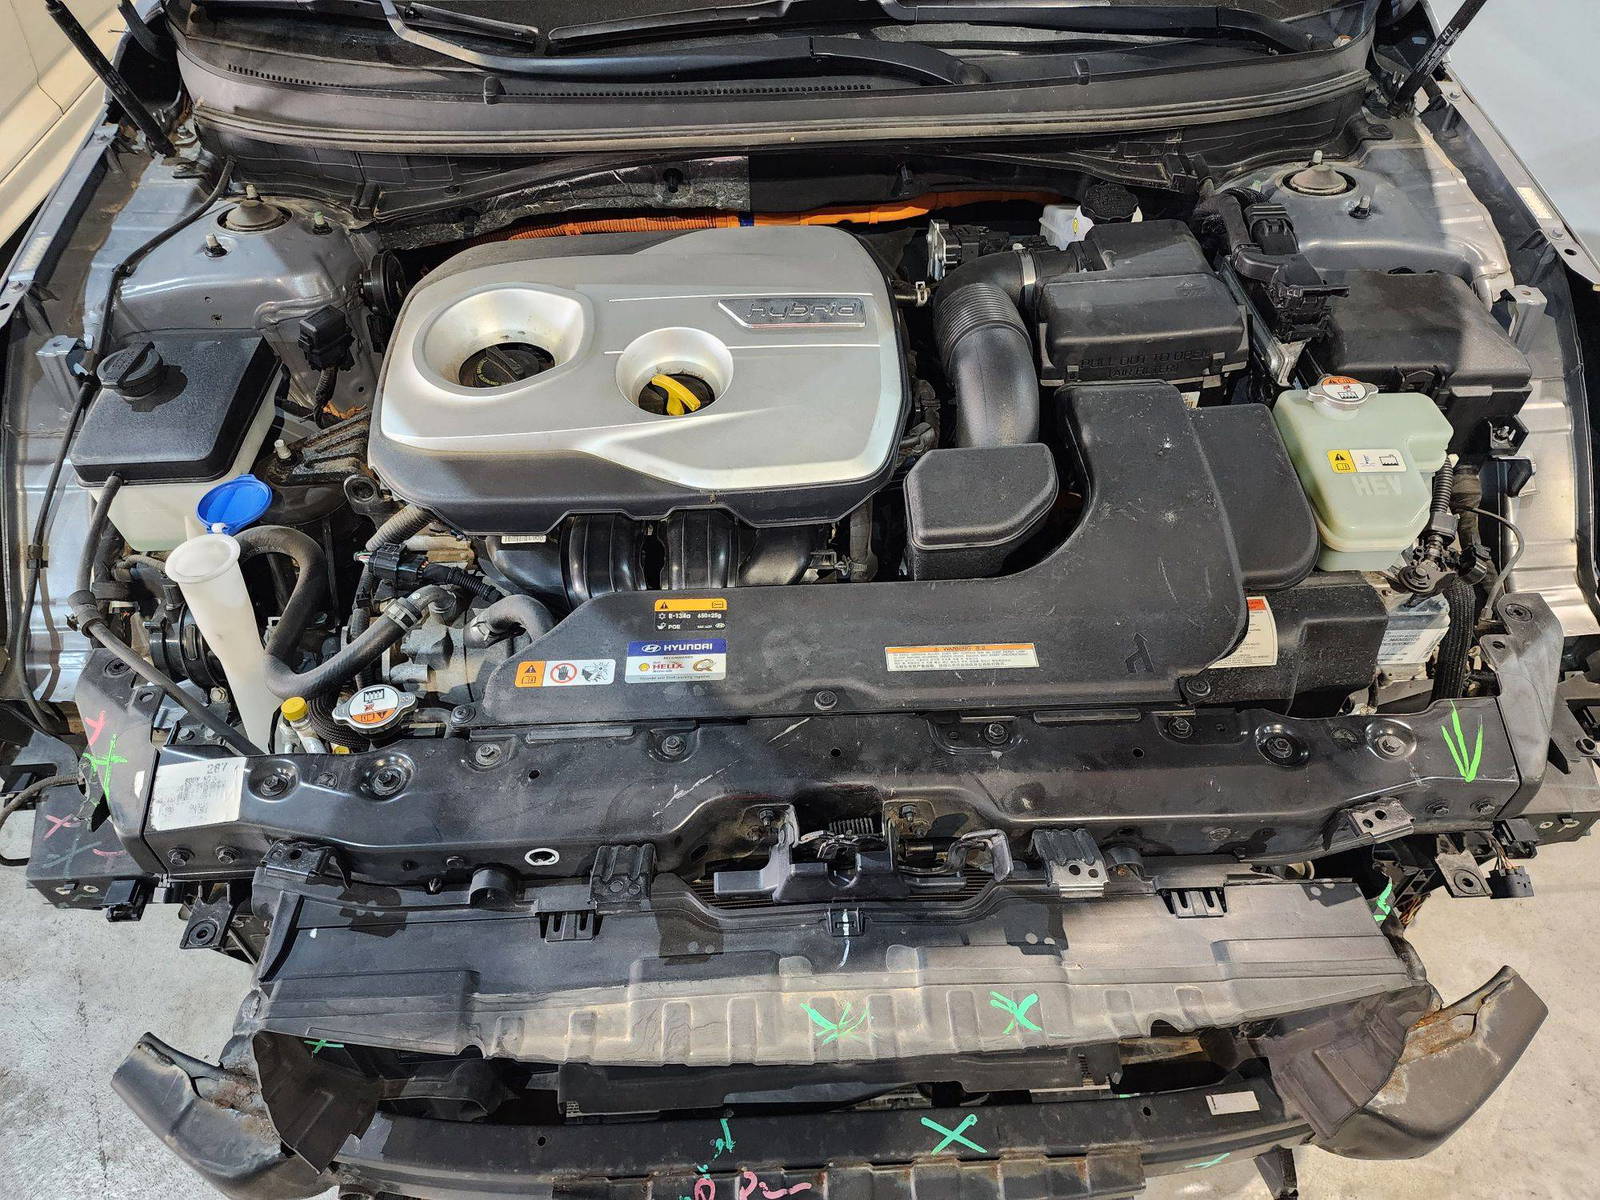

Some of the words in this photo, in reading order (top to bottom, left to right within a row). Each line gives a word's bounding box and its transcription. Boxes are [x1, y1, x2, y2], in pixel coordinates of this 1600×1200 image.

[1080, 358, 1116, 369] PULL
[1120, 353, 1146, 366] OUT
[1153, 352, 1169, 362] TO
[663, 643, 713, 651] HYUNDAI
[653, 662, 685, 670] HELIX
